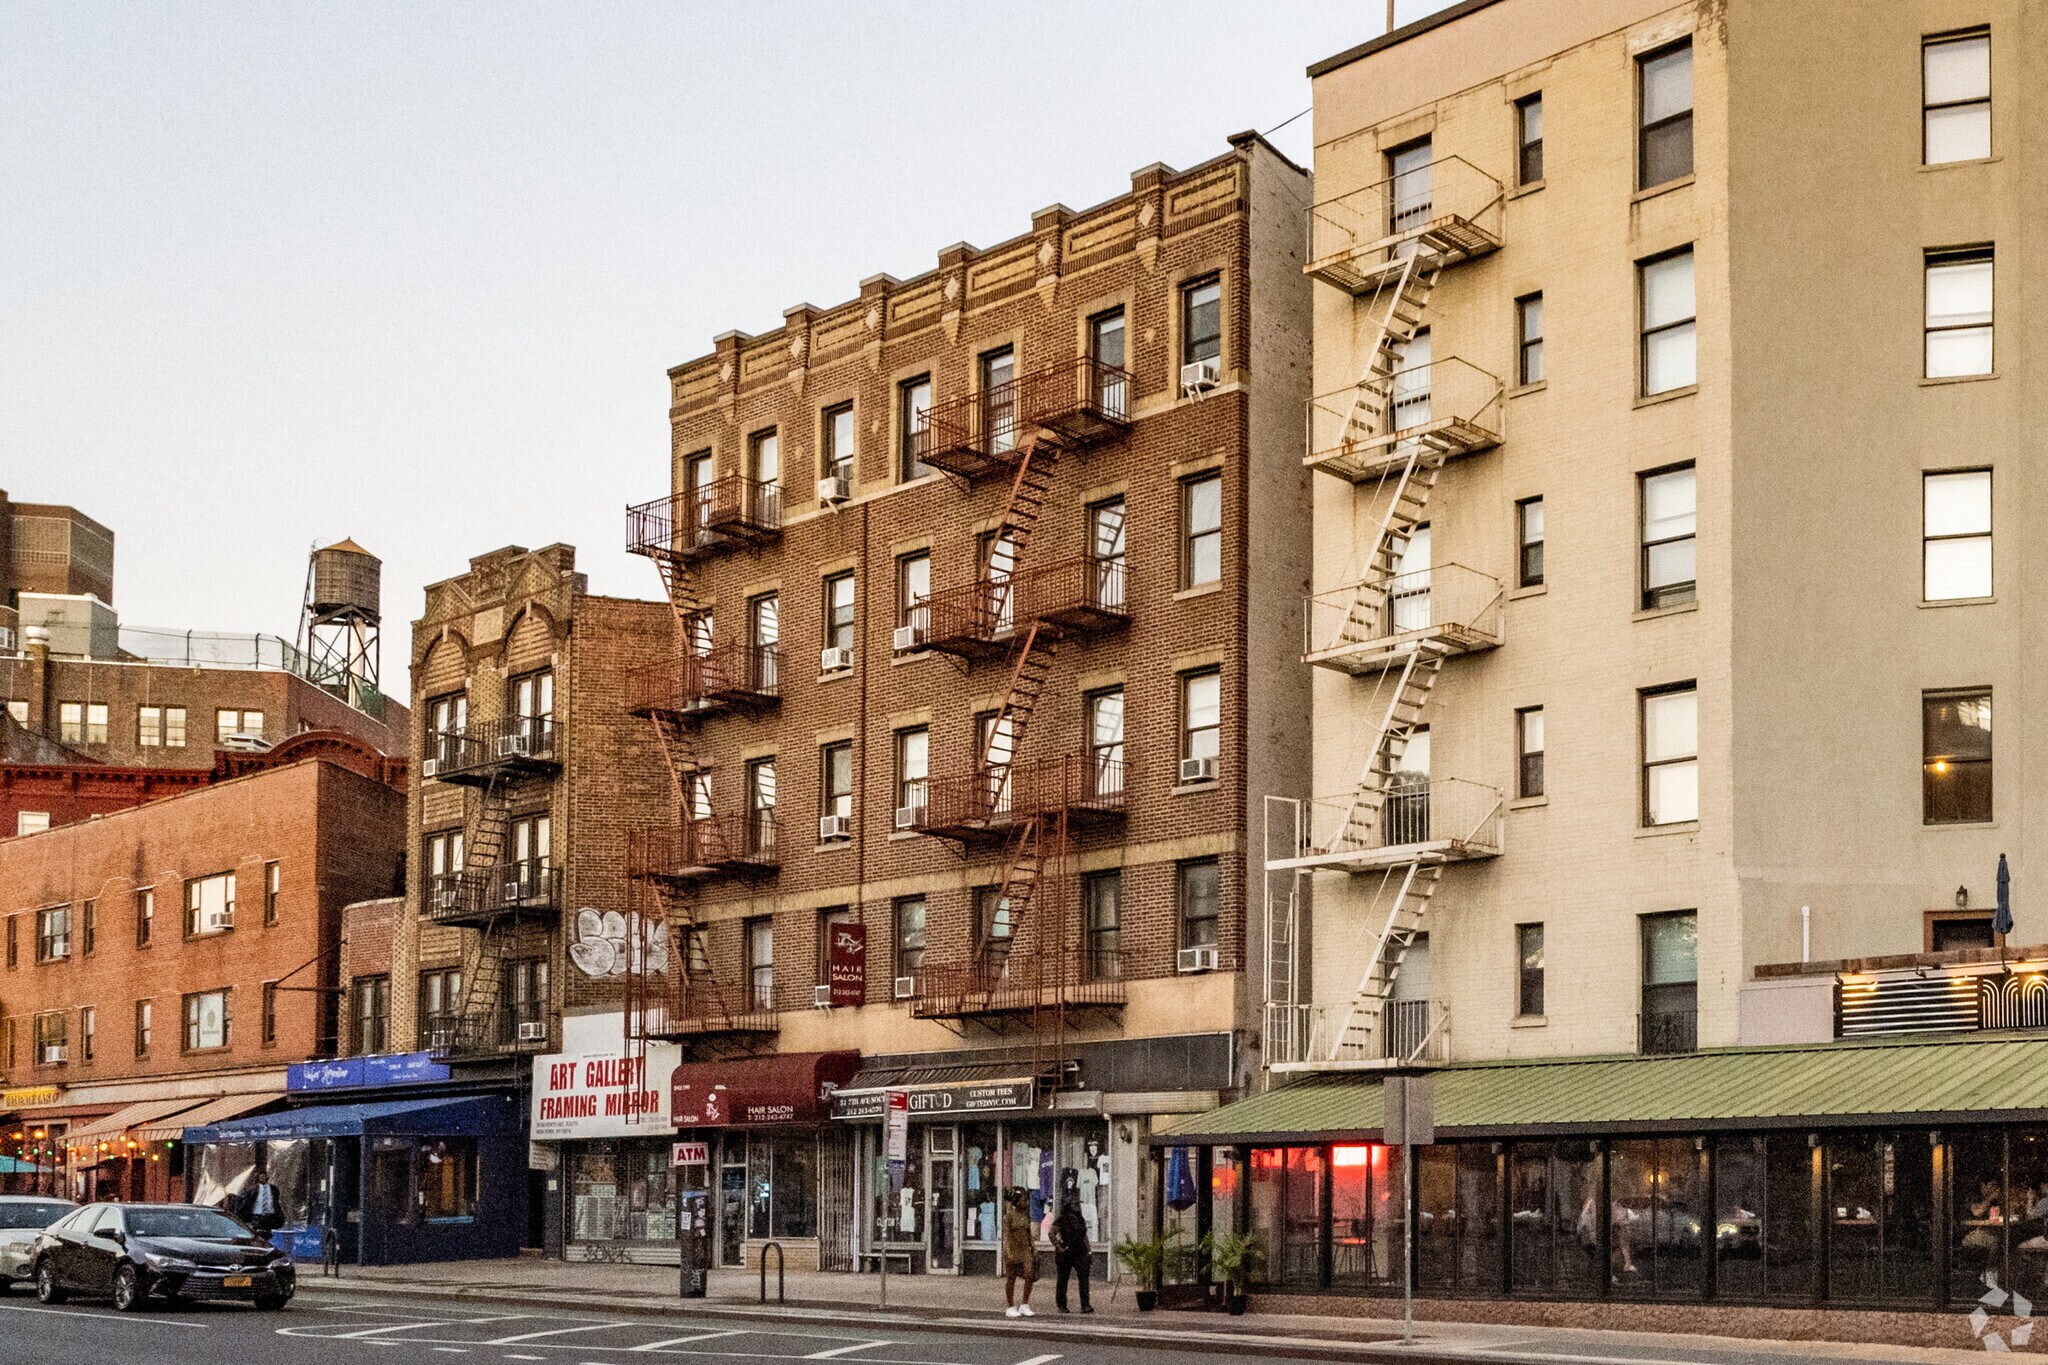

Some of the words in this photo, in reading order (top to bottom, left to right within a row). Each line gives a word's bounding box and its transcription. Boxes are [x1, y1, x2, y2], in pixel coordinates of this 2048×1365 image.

[832, 965, 862, 973] HAIR
[832, 973, 863, 982] SALON
[550, 1063, 577, 1091] ART
[586, 1056, 644, 1088] GALLERY
[871, 1095, 885, 1103] SOUT
[966, 1098, 1016, 1108] GIFTEDNYC.COM
[540, 1095, 597, 1120] FRAMING
[605, 1090, 659, 1117] MIRROR
[748, 1106, 766, 1114] HAIR
[767, 1105, 794, 1113] SALON
[677, 1148, 705, 1161] ATM
